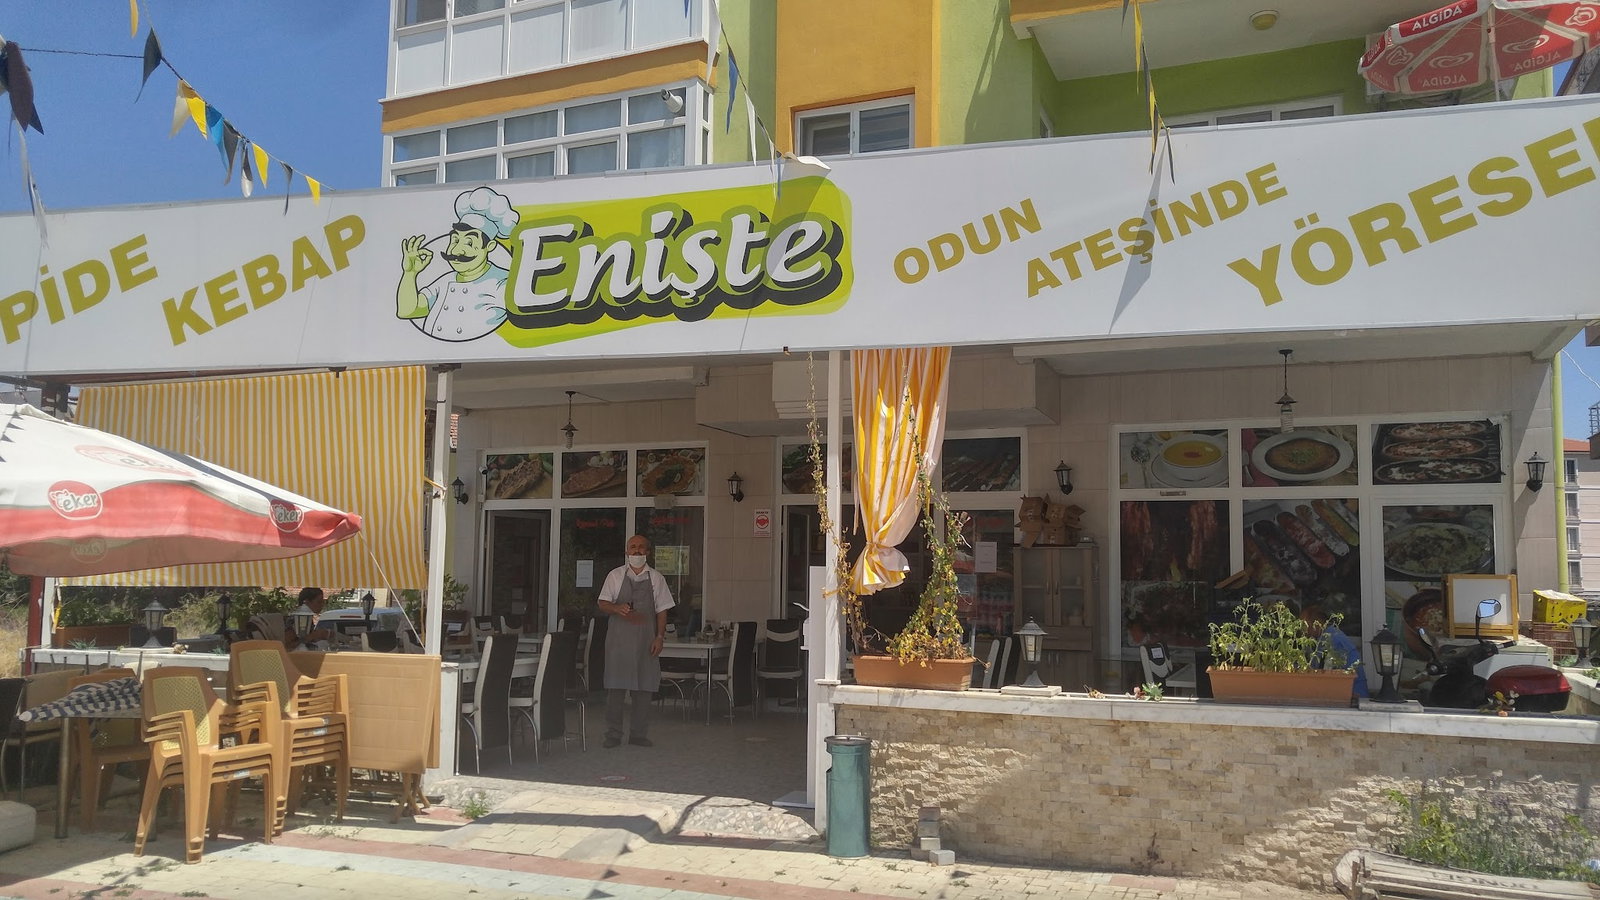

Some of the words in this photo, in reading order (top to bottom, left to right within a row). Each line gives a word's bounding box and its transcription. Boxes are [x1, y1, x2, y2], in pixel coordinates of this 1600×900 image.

[161, 214, 366, 346] KEBAP
[510, 207, 834, 314] Enişte
[893, 198, 1043, 284] ODUN
[1027, 162, 1289, 299] ATEŞİNDE
[0, 233, 158, 345] PİDE
[63, 493, 98, 510] eker
[277, 508, 300, 521] eker
